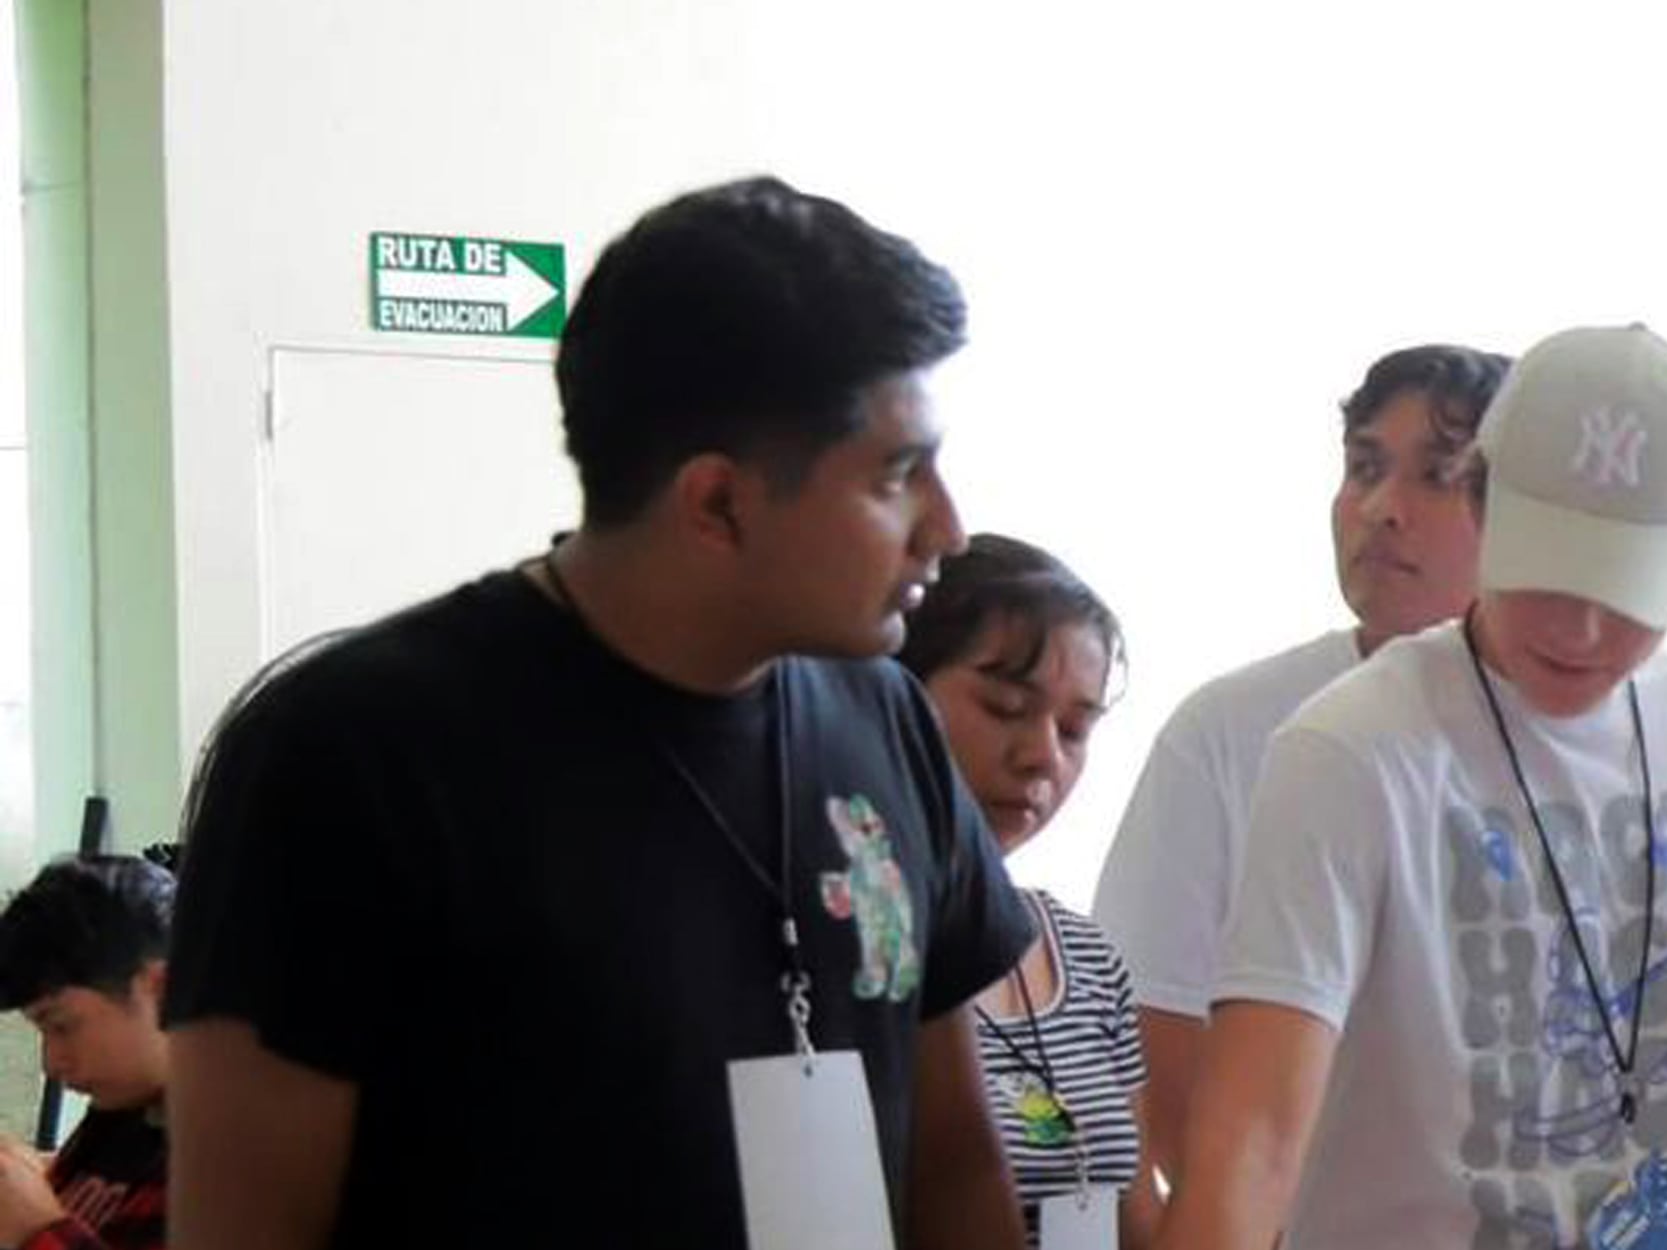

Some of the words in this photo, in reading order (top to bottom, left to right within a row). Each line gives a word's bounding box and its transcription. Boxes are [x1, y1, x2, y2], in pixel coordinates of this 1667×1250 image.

[377, 236, 456, 270] RUTA
[463, 241, 502, 273] DE
[379, 302, 503, 332] EVACUACION
